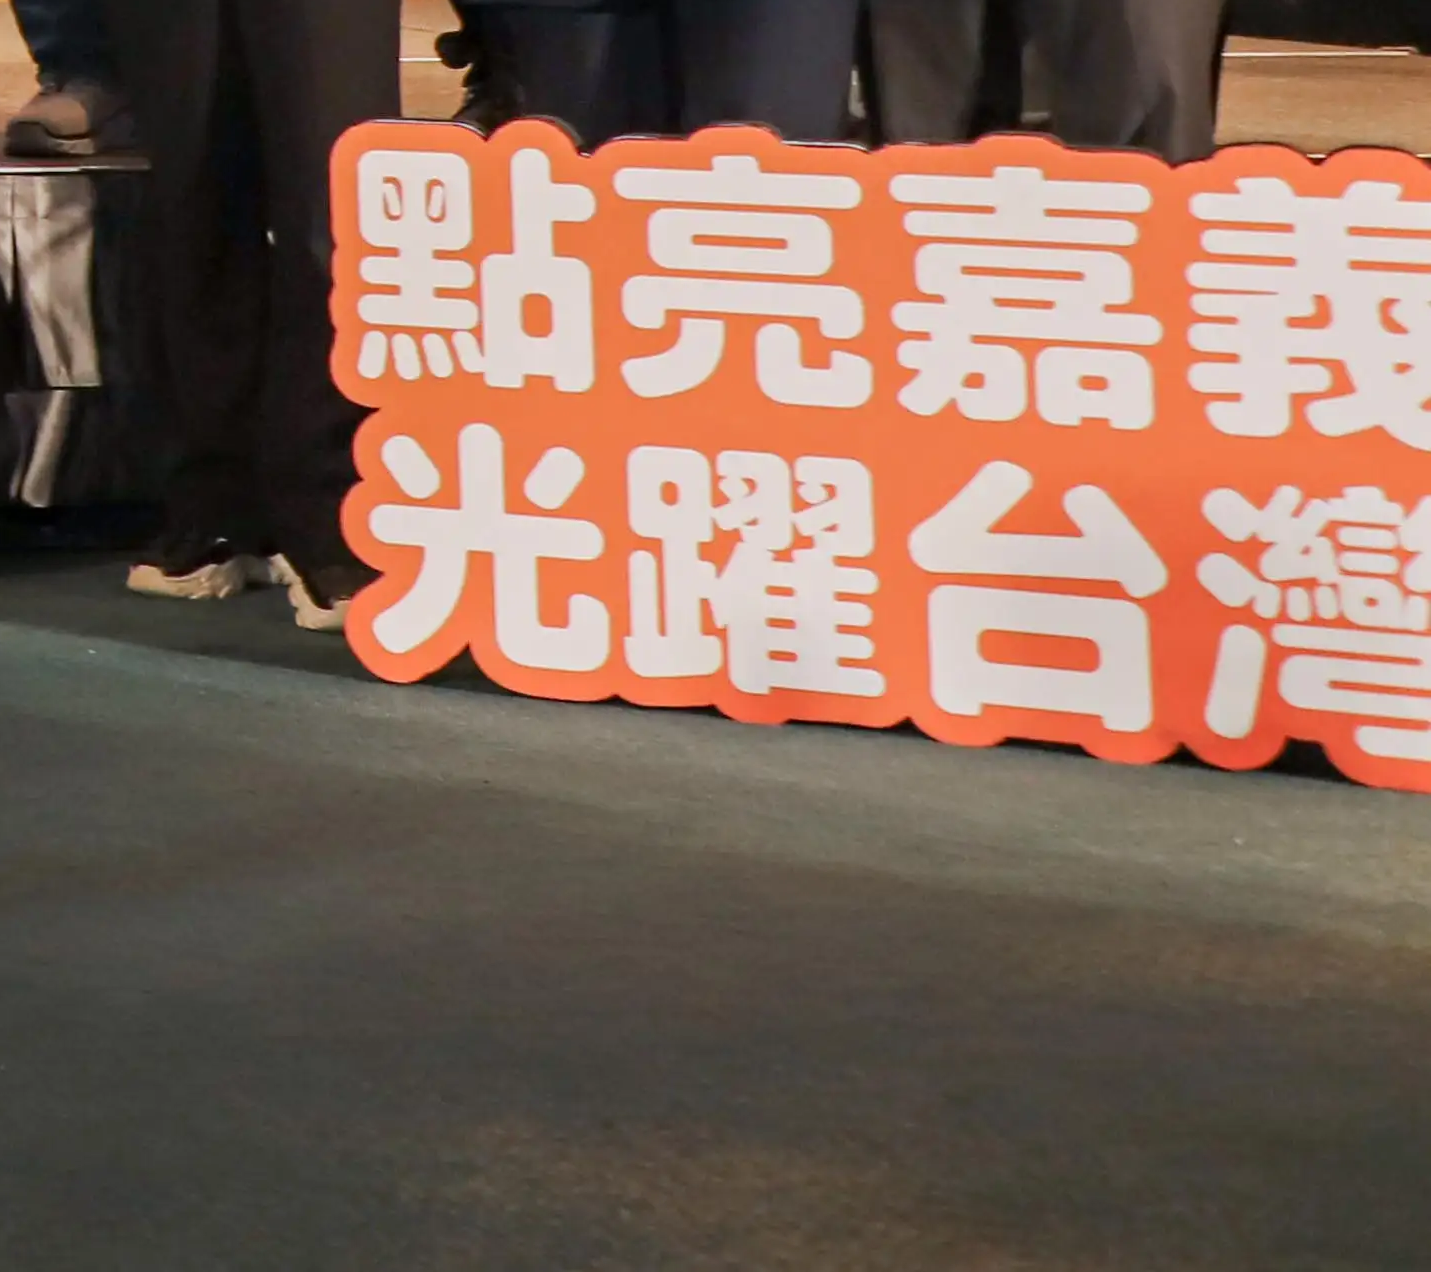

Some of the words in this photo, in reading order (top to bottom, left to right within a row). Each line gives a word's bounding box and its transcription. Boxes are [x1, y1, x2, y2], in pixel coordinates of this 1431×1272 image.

[355, 146, 1431, 453] 點亮嘉義
[367, 420, 1431, 764] 光躍台灣
